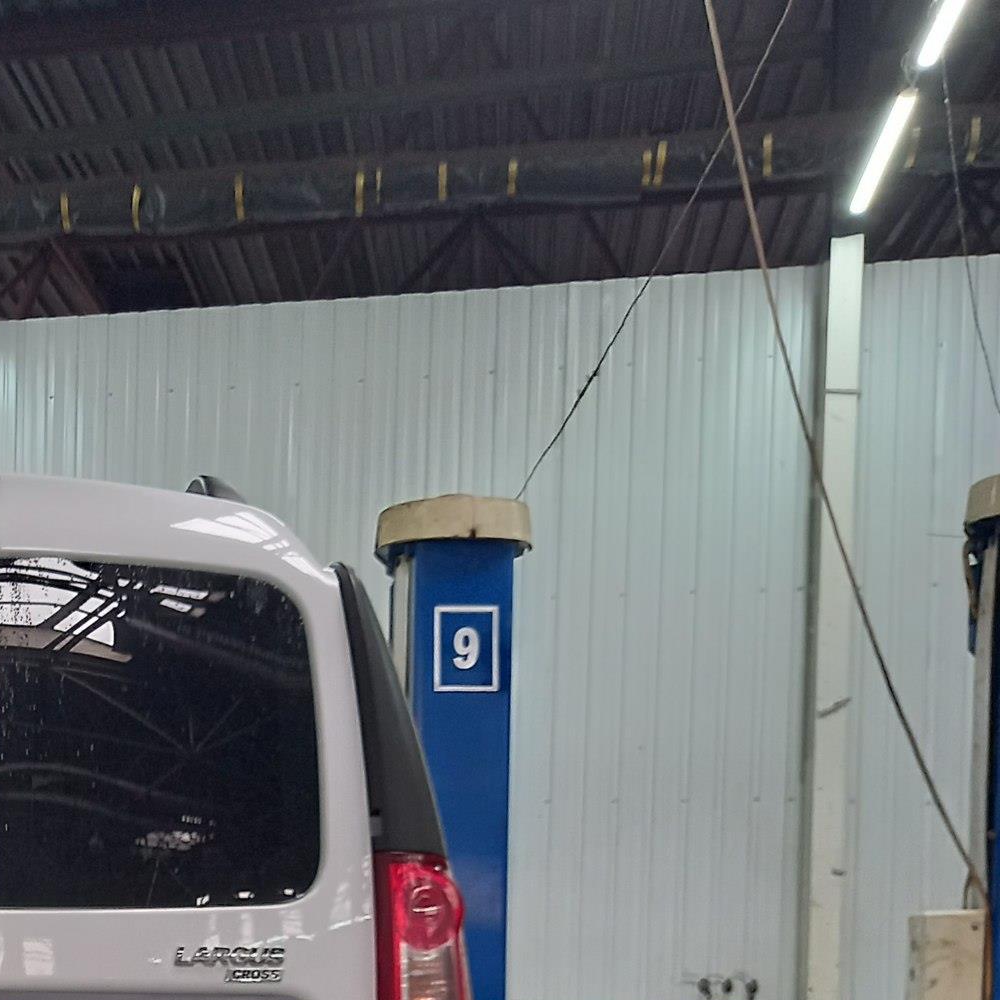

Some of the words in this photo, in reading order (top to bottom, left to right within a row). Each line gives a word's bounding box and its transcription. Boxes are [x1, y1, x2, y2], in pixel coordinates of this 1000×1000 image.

[453, 627, 480, 669] 9
[174, 946, 285, 967] LARGUS
[231, 969, 281, 979] CROSS
